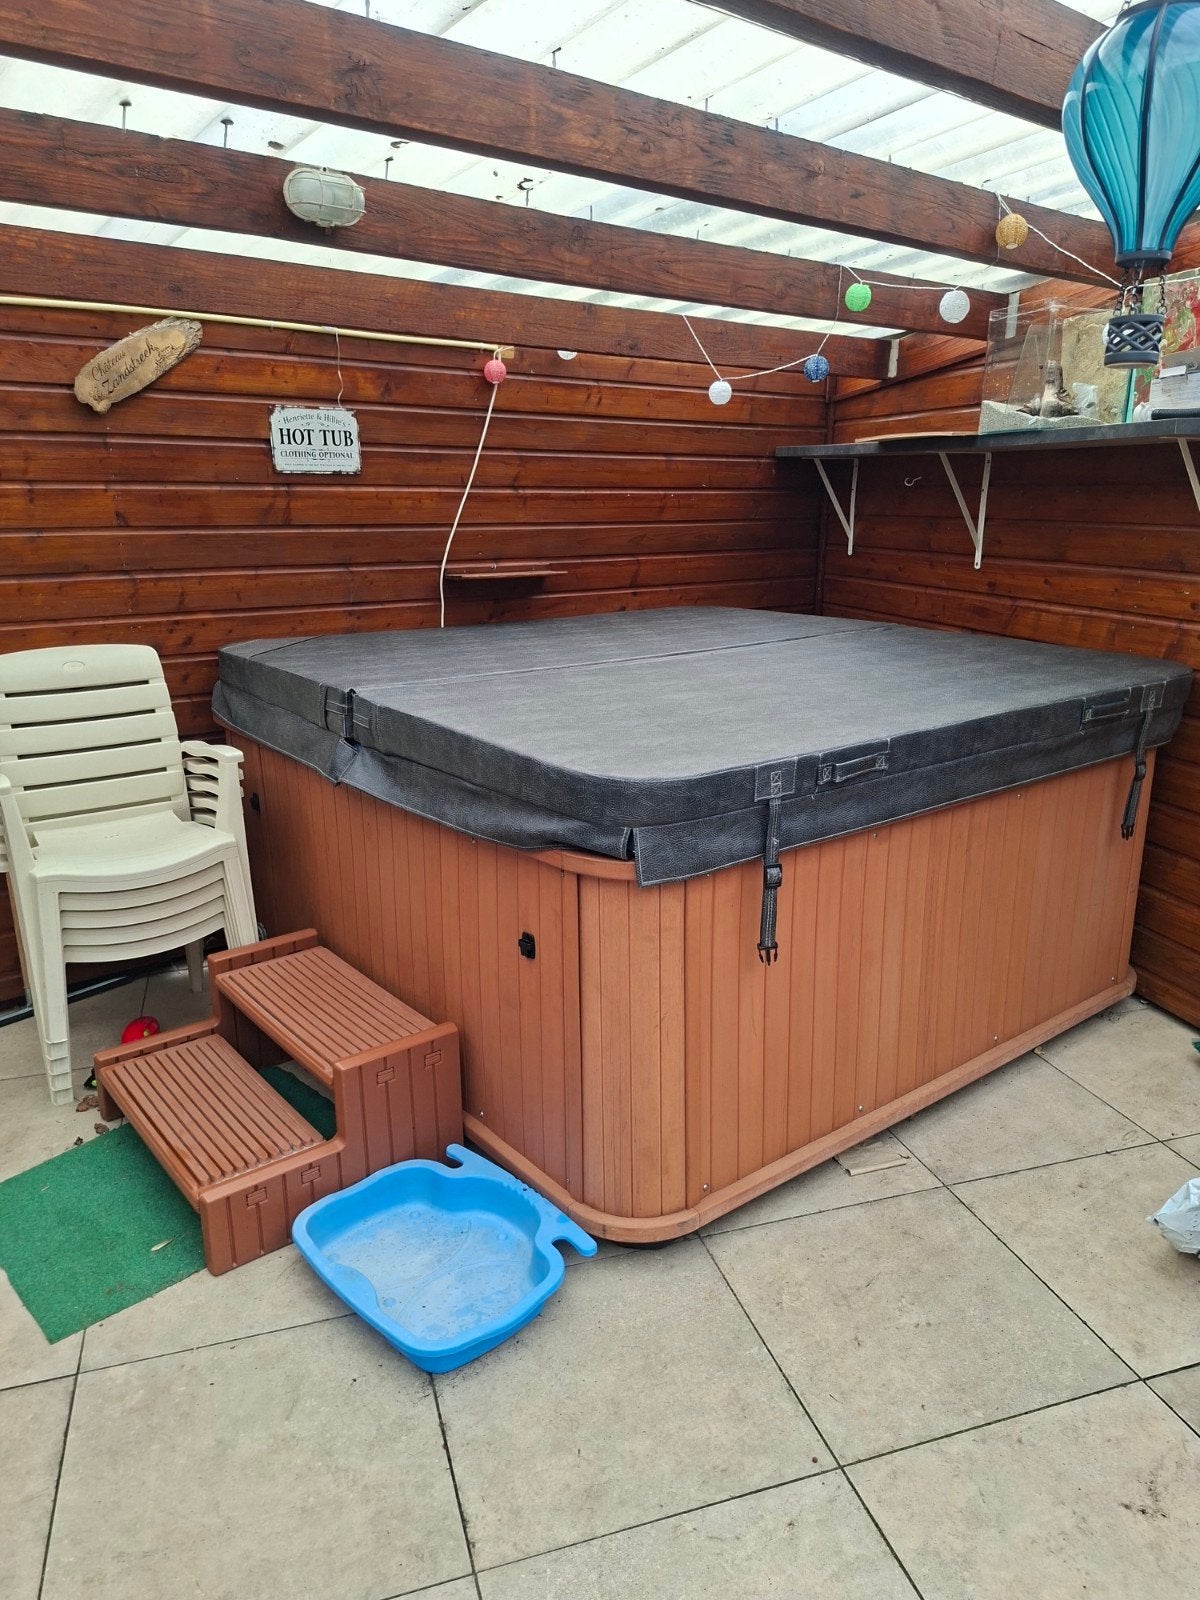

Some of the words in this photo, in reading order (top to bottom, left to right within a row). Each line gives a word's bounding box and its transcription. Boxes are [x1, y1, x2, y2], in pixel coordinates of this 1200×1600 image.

[102, 338, 160, 393] Zandstreek
[279, 428, 314, 445] HOT
[319, 430, 354, 446] TUB
